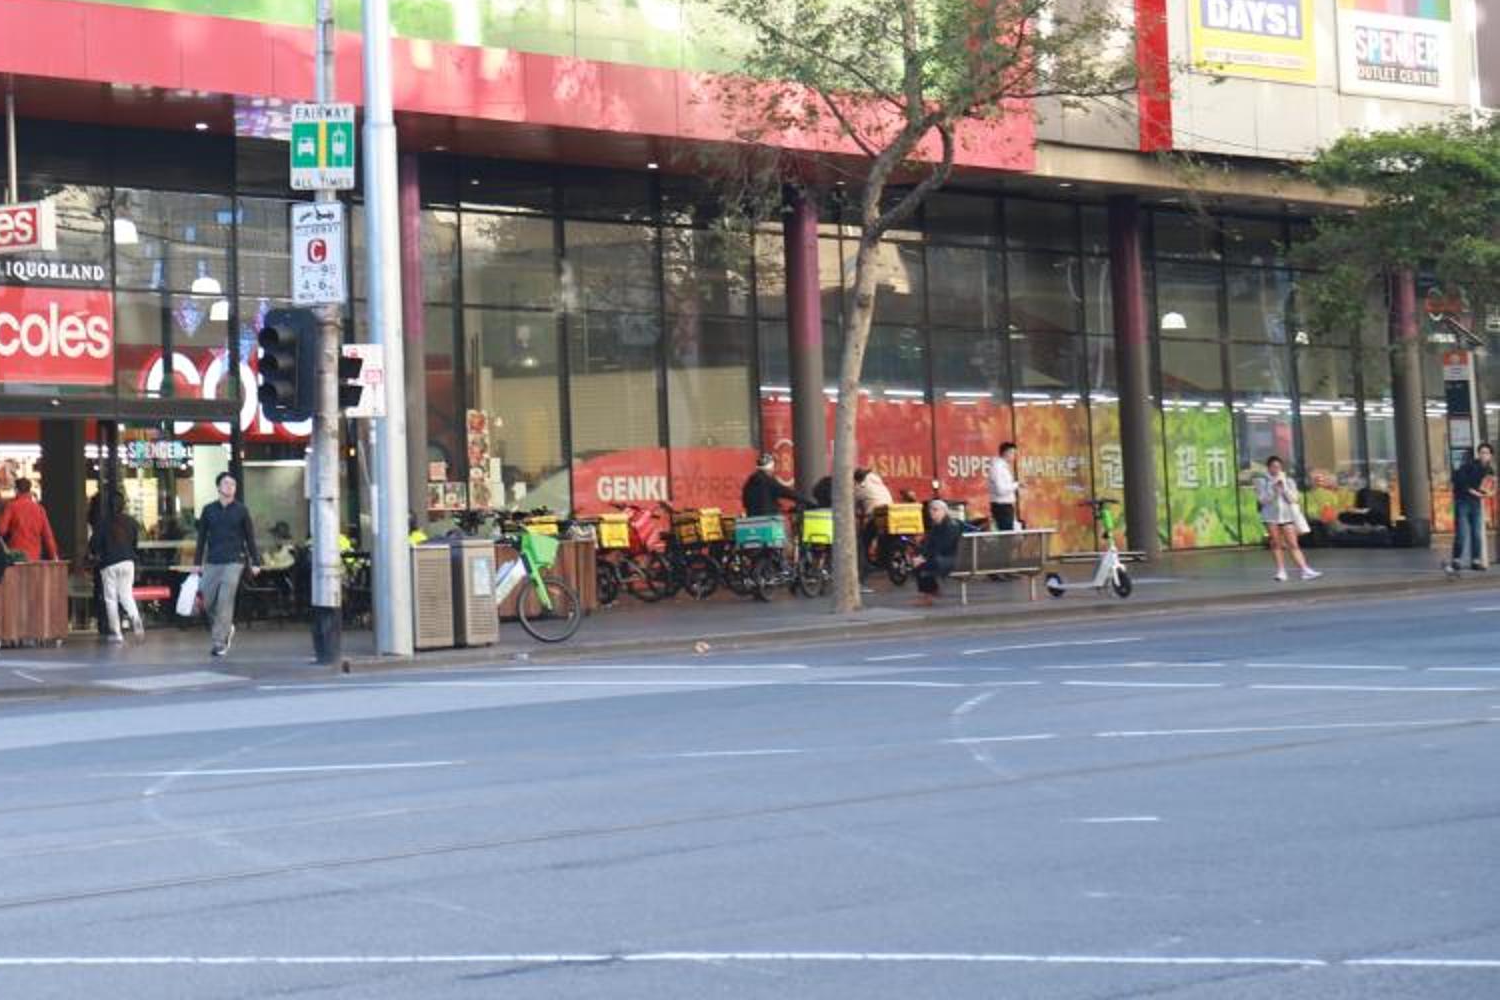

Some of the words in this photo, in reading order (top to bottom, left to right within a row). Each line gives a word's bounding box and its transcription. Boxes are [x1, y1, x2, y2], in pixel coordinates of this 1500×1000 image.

[1355, 28, 1438, 69] SPENCER
[128, 441, 183, 458] SPENCER
[868, 456, 923, 477] ASIAN
[947, 455, 992, 477] SUPE
[1175, 446, 1227, 488] 超市
[597, 475, 667, 501] GENKI
